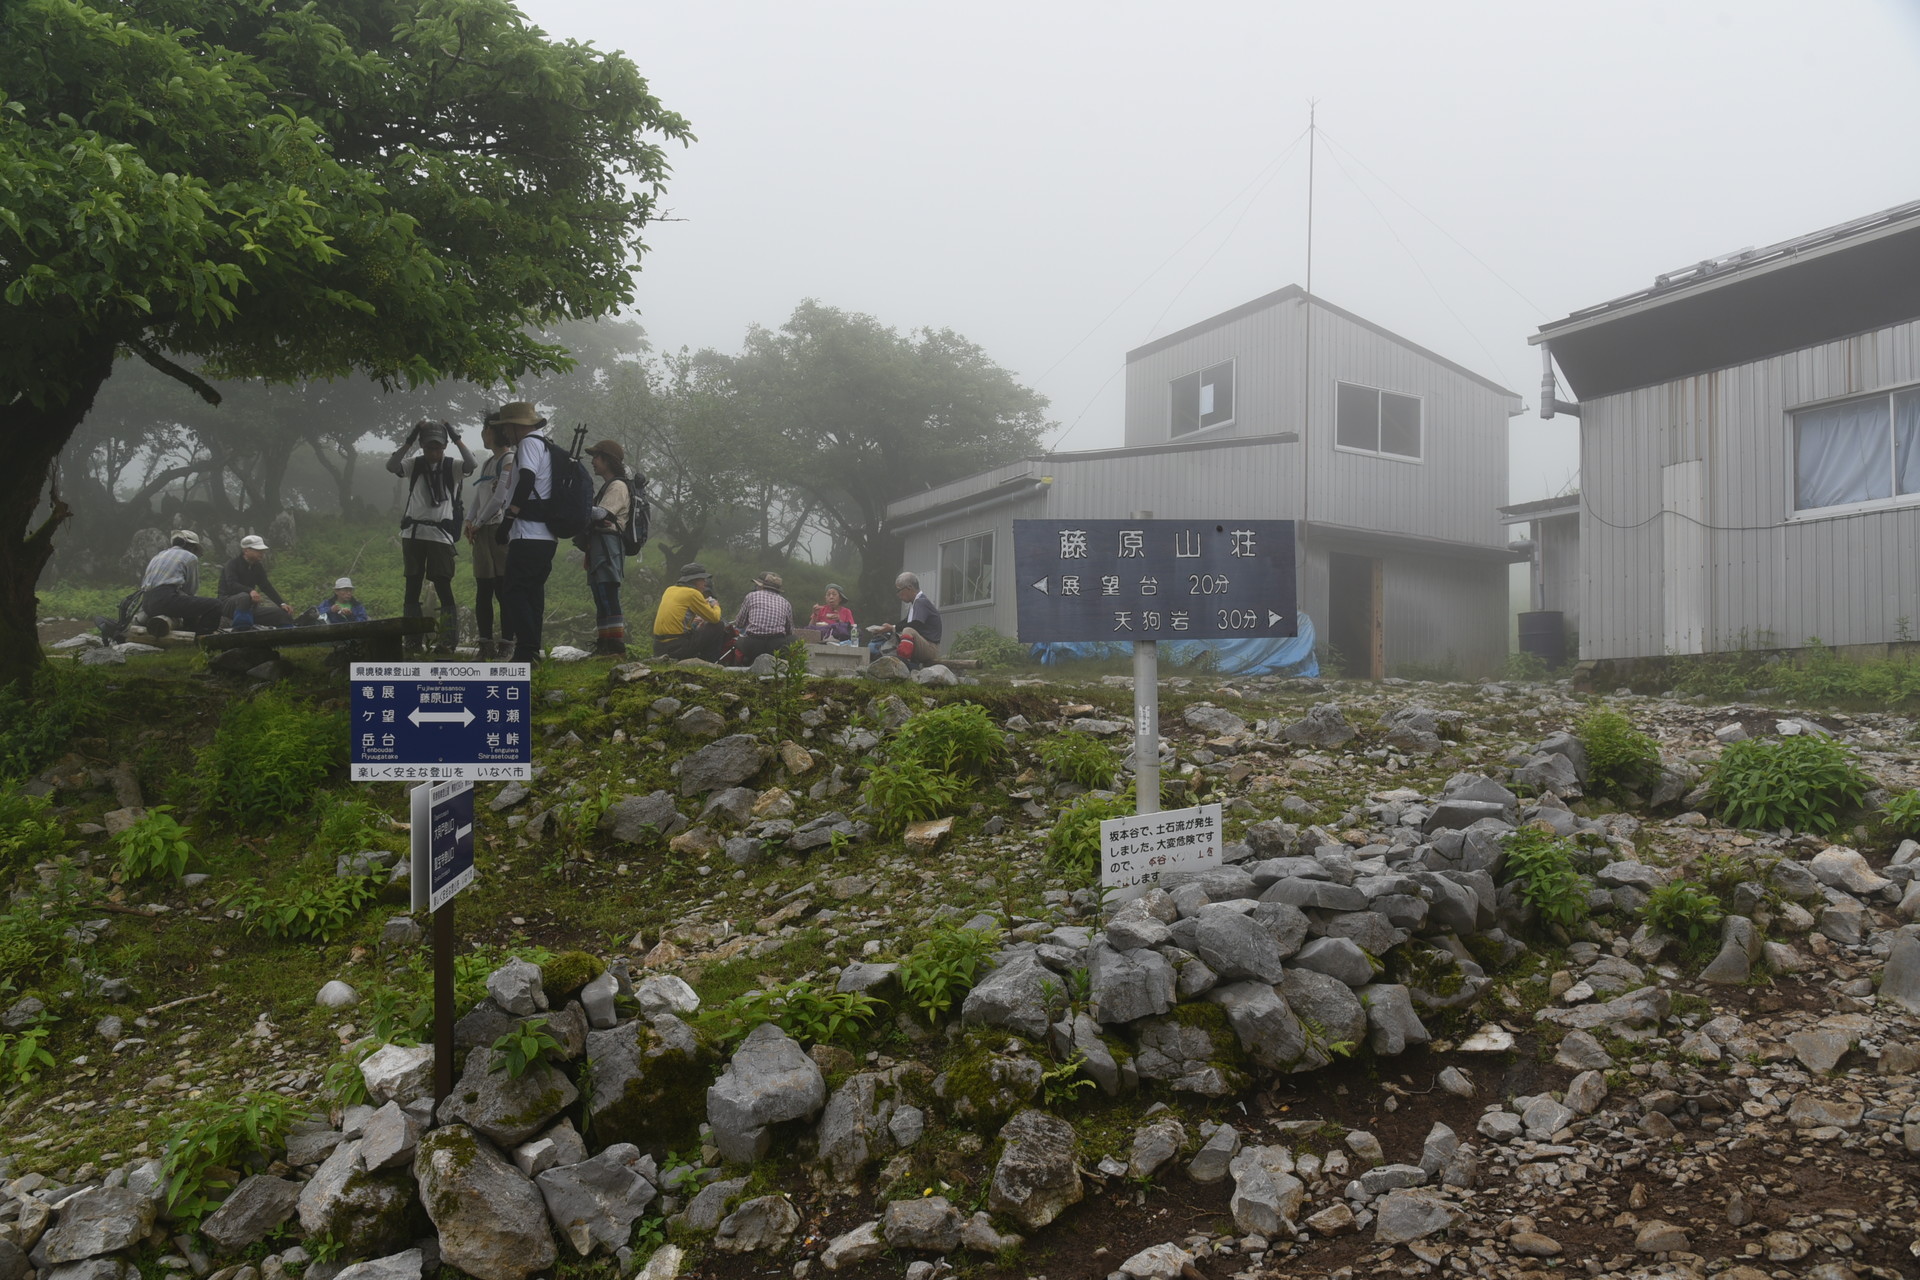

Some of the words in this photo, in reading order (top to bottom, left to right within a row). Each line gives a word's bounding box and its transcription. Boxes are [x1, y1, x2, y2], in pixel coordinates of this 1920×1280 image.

[1059, 529, 1256, 559] 藤原山荘
[1061, 575, 1158, 596] 展望台
[1189, 574, 1229, 595] 20分
[1114, 610, 1189, 631] 天狗岩
[1218, 609, 1257, 629] 30分
[430, 667, 481, 677] 標高1090m
[490, 667, 526, 677] 藤原山荘
[419, 693, 463, 704] 藤原山荘
[382, 686, 395, 746] 展望台
[486, 686, 500, 746] 天狗岩
[506, 686, 519, 746] 白瀬峠
[358, 767, 464, 778] 楽しく安全な登山を
[477, 767, 524, 778] いなべ市
